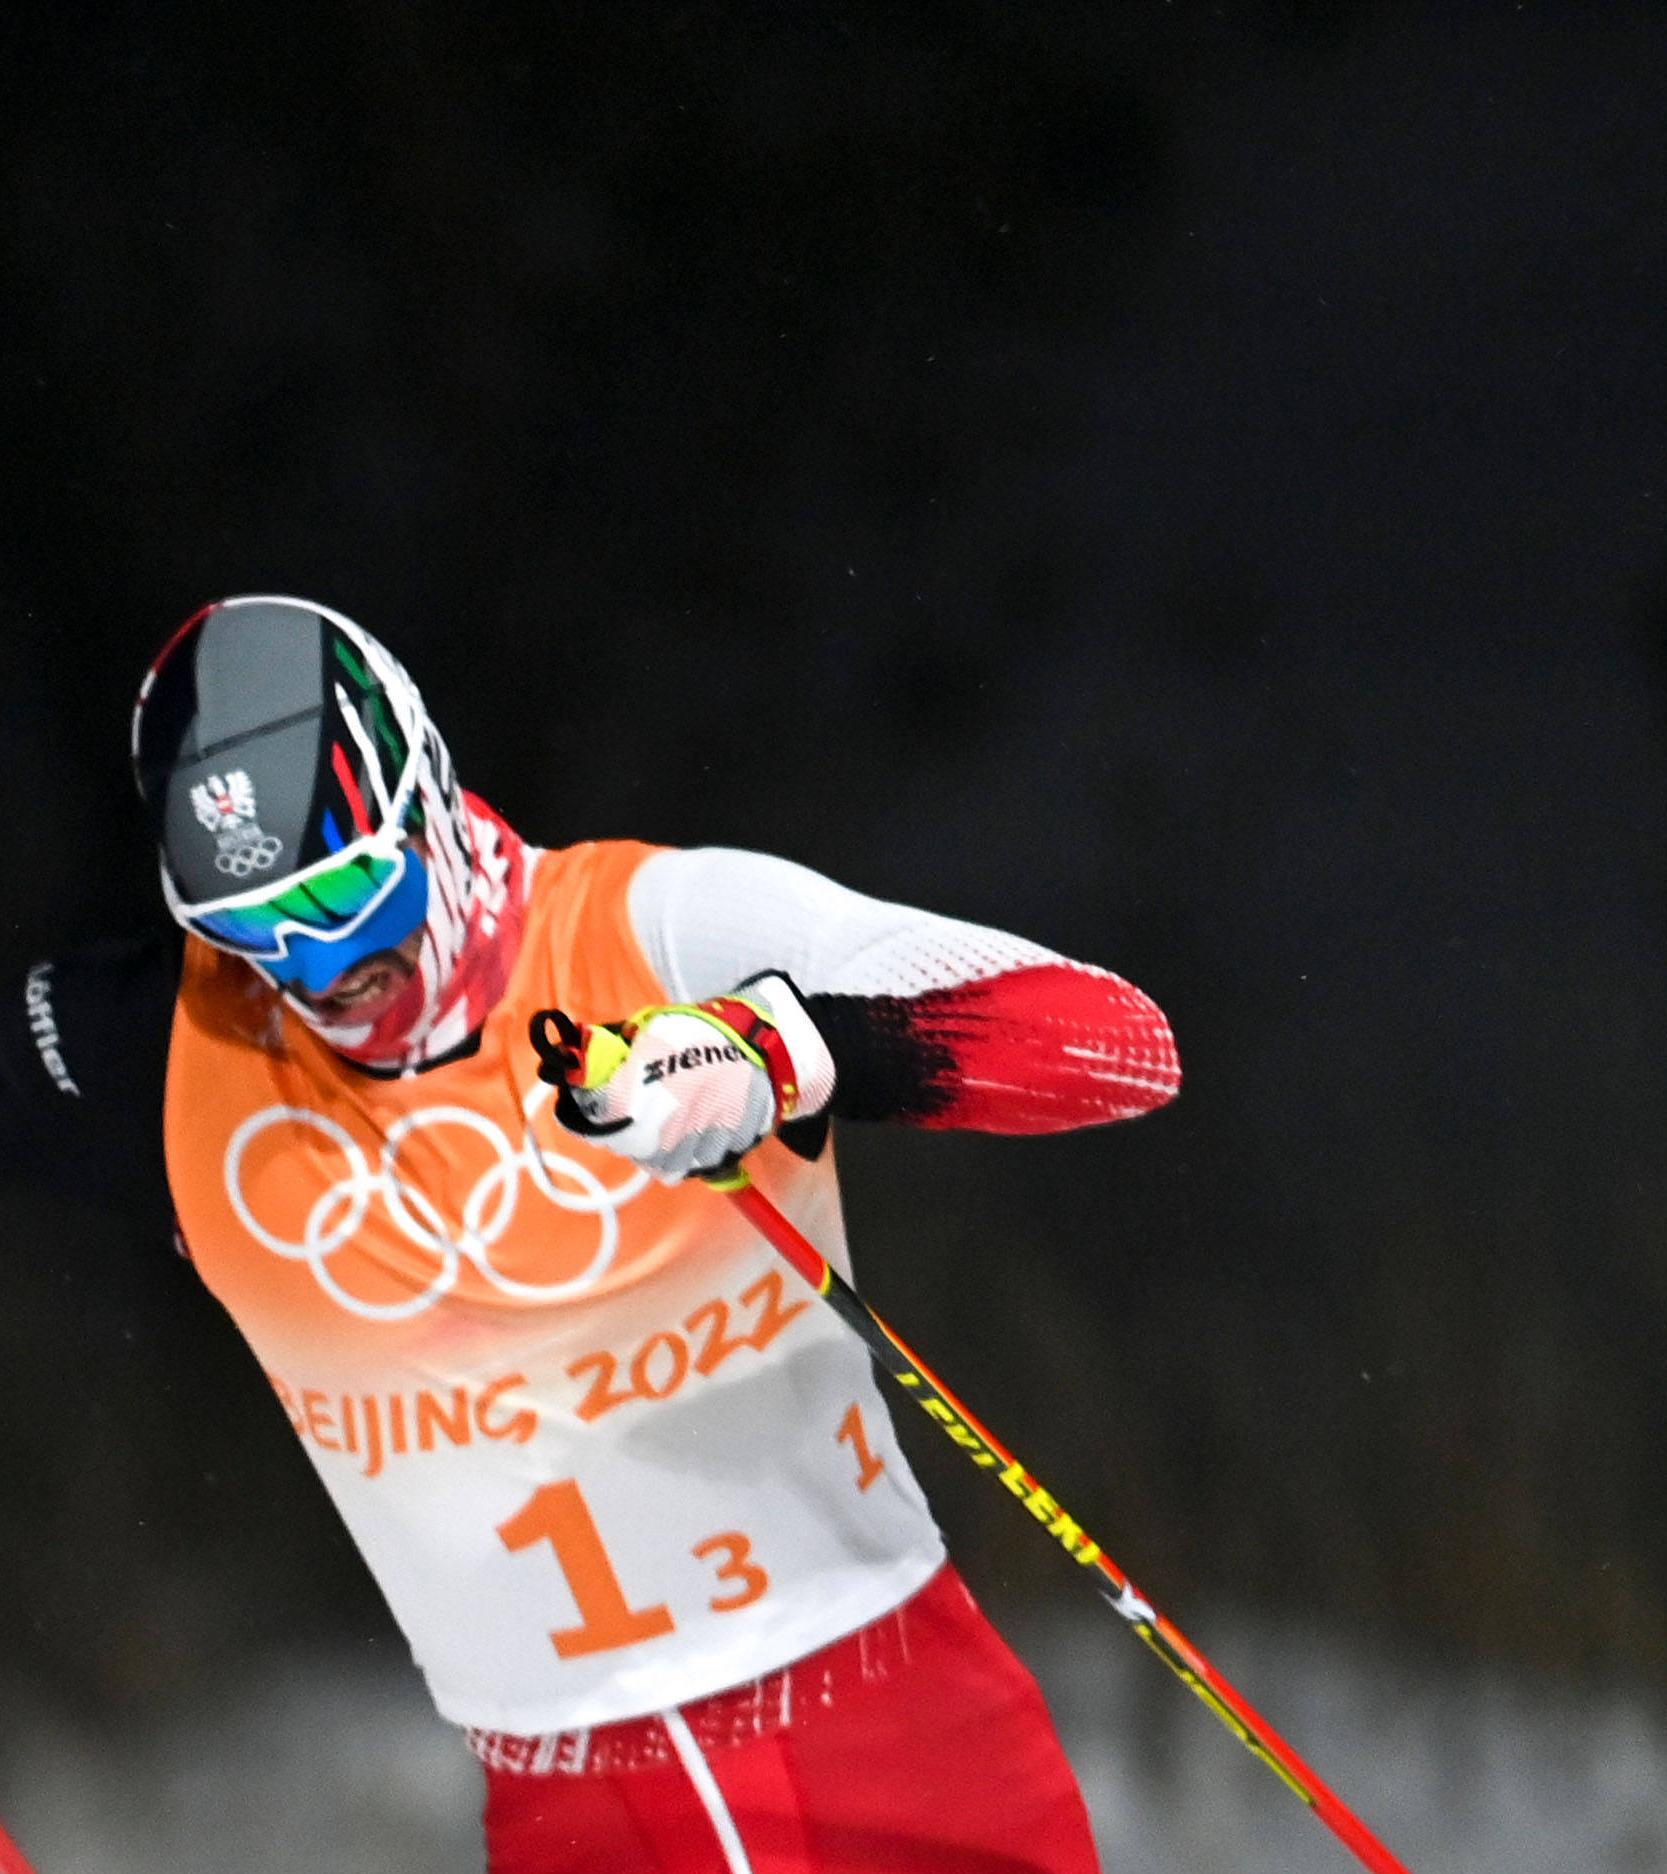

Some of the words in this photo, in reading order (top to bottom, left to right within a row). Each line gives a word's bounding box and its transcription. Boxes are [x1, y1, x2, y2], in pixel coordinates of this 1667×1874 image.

[567, 1272, 810, 1423] 2022
[839, 1405, 884, 1491] 1
[498, 1479, 676, 1659] 1
[694, 1533, 769, 1613] 3
